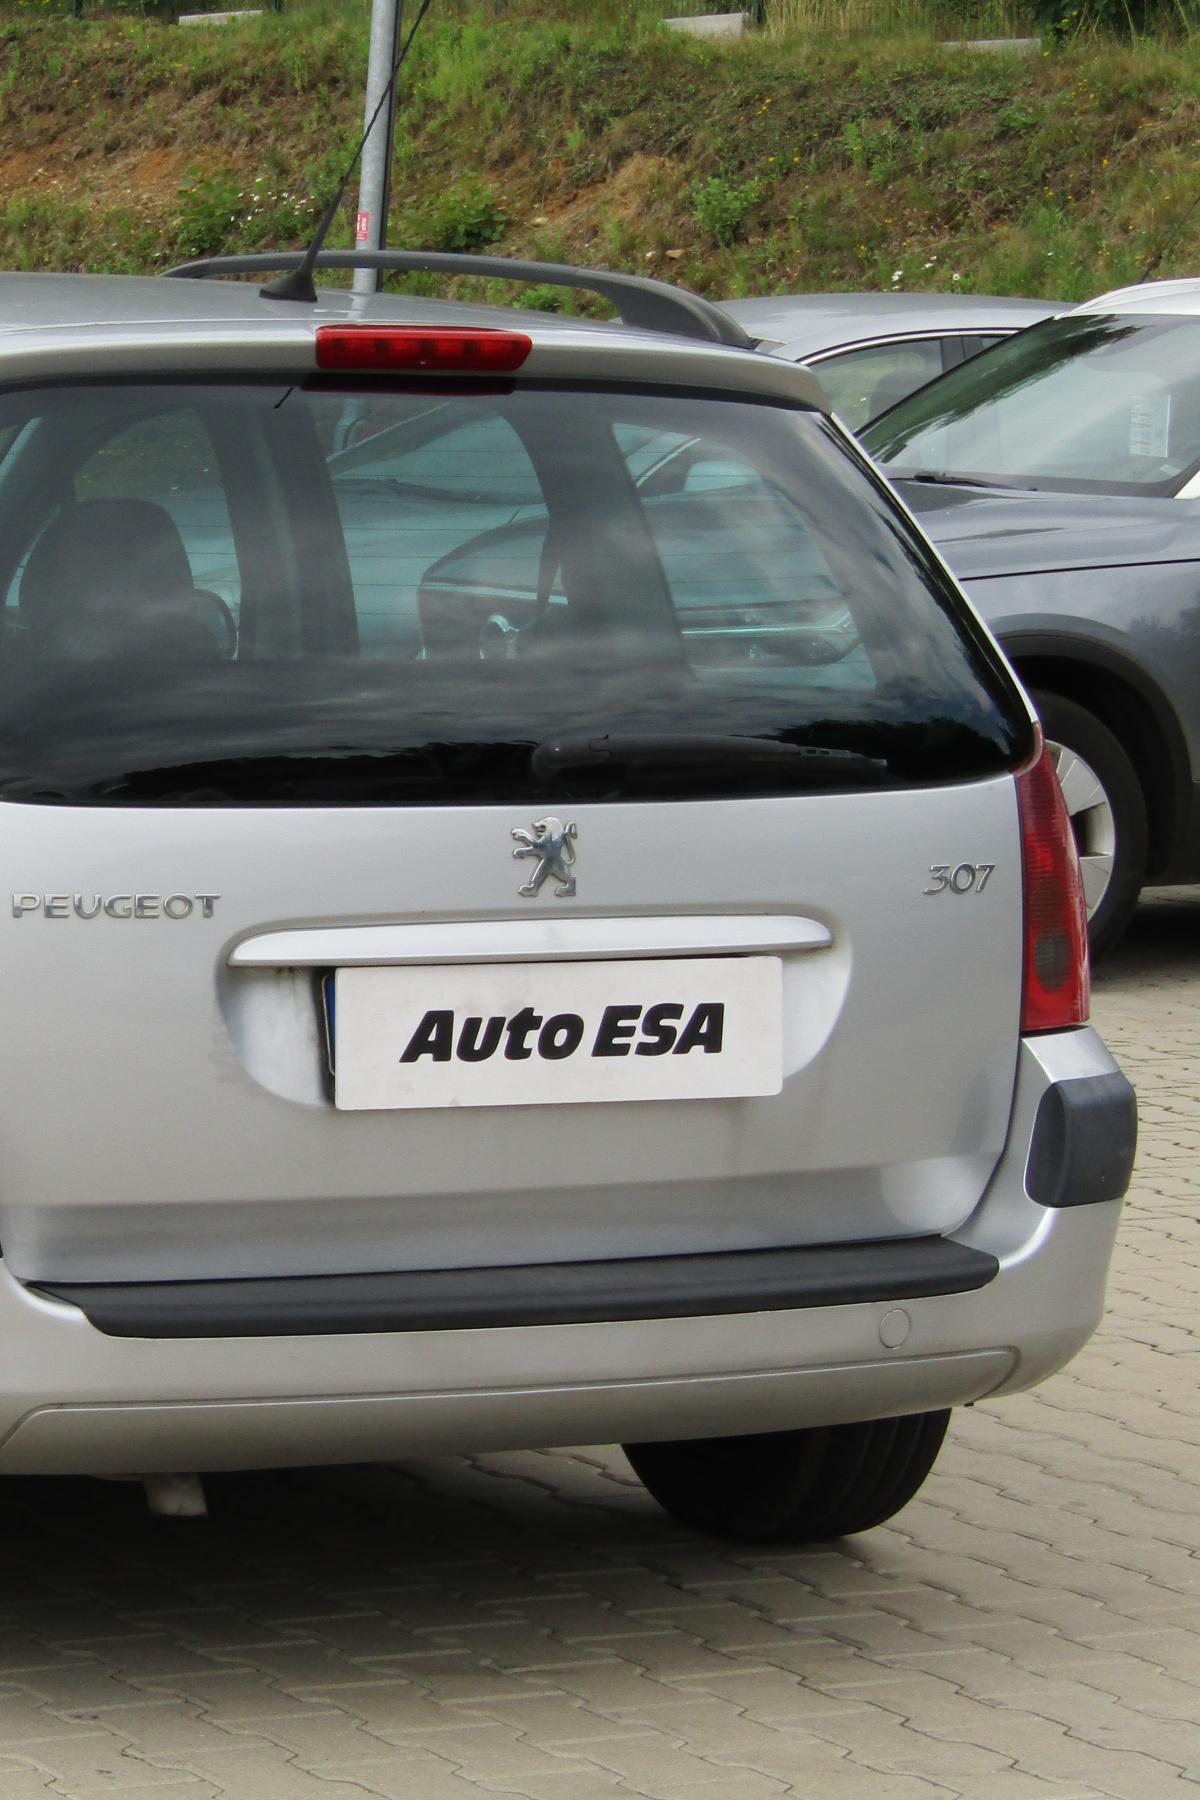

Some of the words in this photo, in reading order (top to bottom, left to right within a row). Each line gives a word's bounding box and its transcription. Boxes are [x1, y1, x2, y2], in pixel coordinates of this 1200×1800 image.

[923, 862, 996, 895] 307
[12, 892, 222, 919] PEUGEOT
[399, 1007, 584, 1062] Auto
[591, 1002, 724, 1057] ESA
